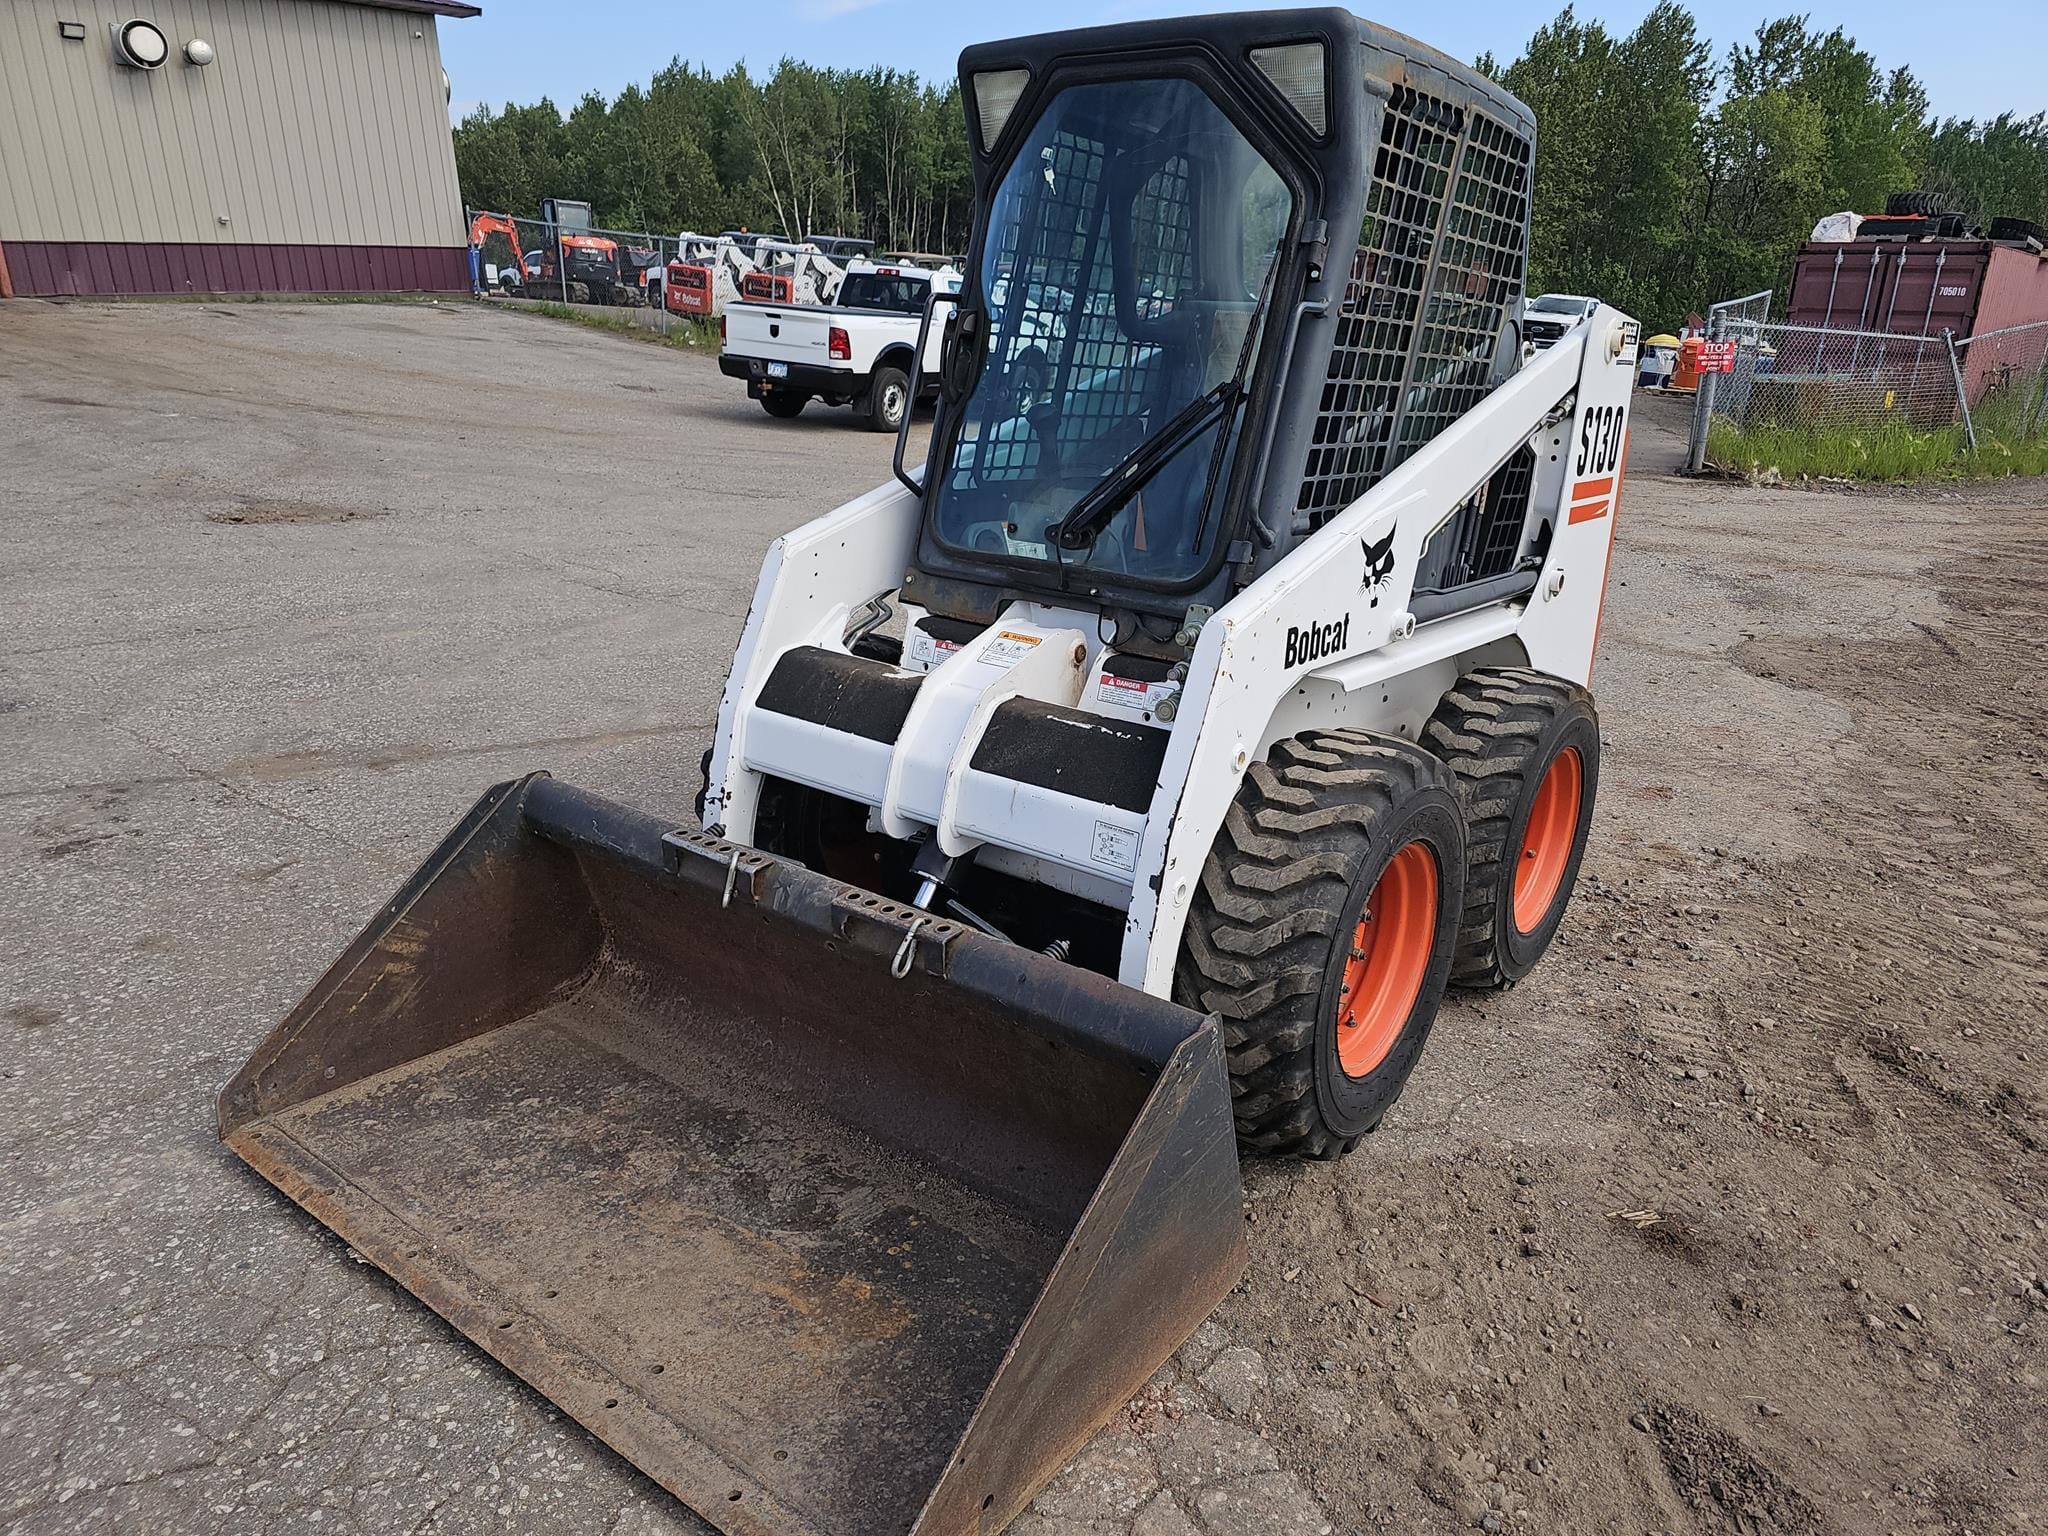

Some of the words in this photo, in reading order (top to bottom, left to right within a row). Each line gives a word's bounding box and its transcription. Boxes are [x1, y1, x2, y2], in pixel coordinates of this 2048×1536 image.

[1939, 286, 1966, 296] 705010
[1704, 343, 1730, 353] STOP
[1577, 406, 1624, 477] S130
[1284, 612, 1350, 670] Bobcat
[1116, 679, 1141, 690] DANGER
